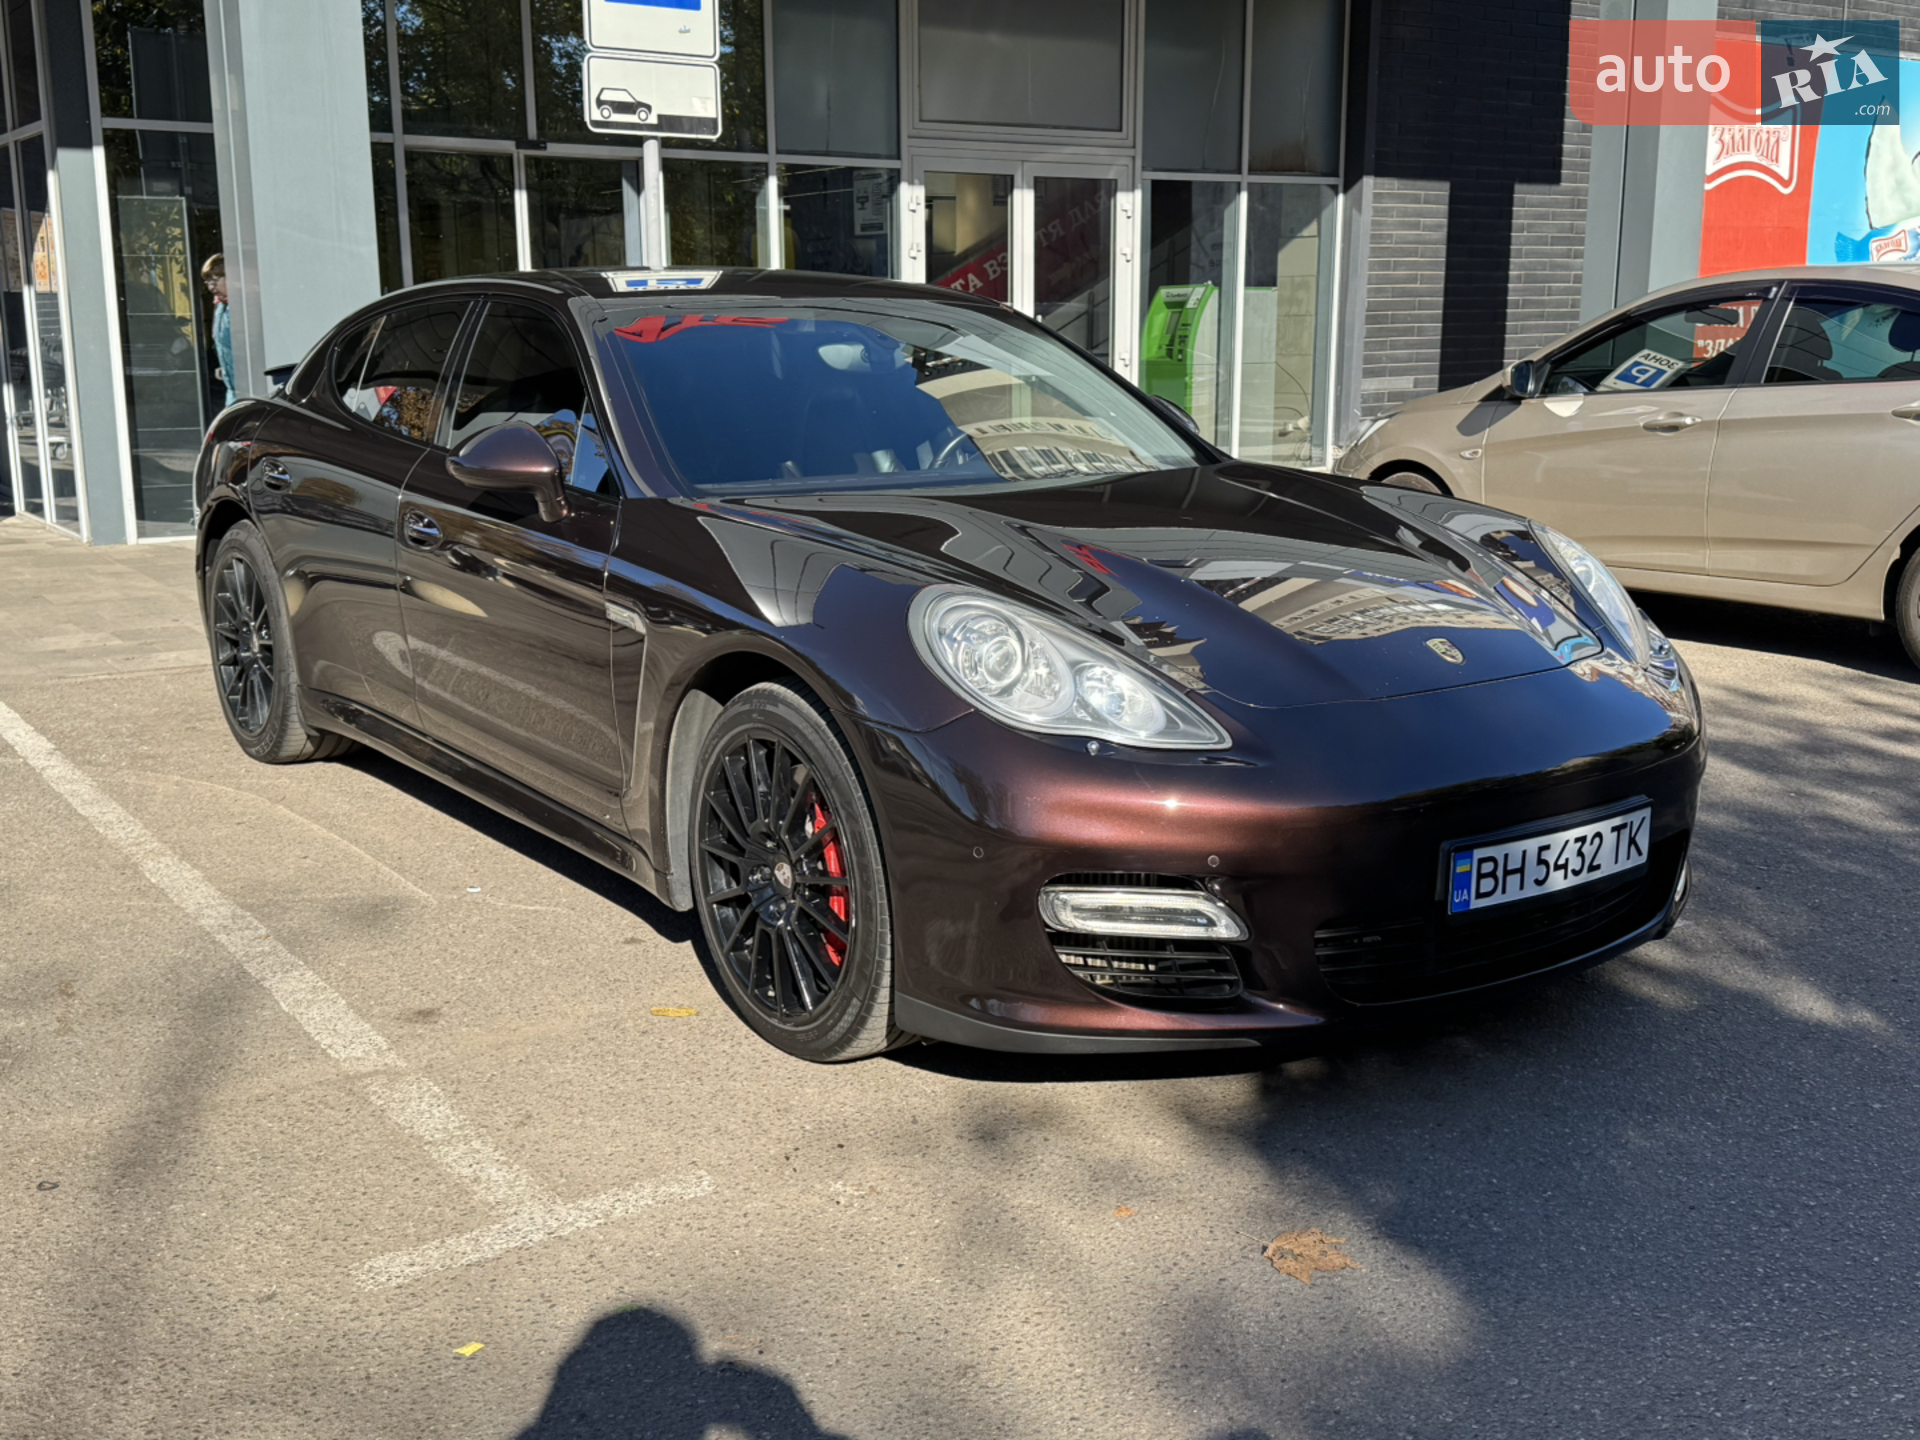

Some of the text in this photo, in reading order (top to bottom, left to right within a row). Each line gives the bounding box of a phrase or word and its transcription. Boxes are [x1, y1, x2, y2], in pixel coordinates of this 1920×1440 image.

[1474, 815, 1647, 900] BH 5432 TK
[1453, 889, 1469, 903] UA
